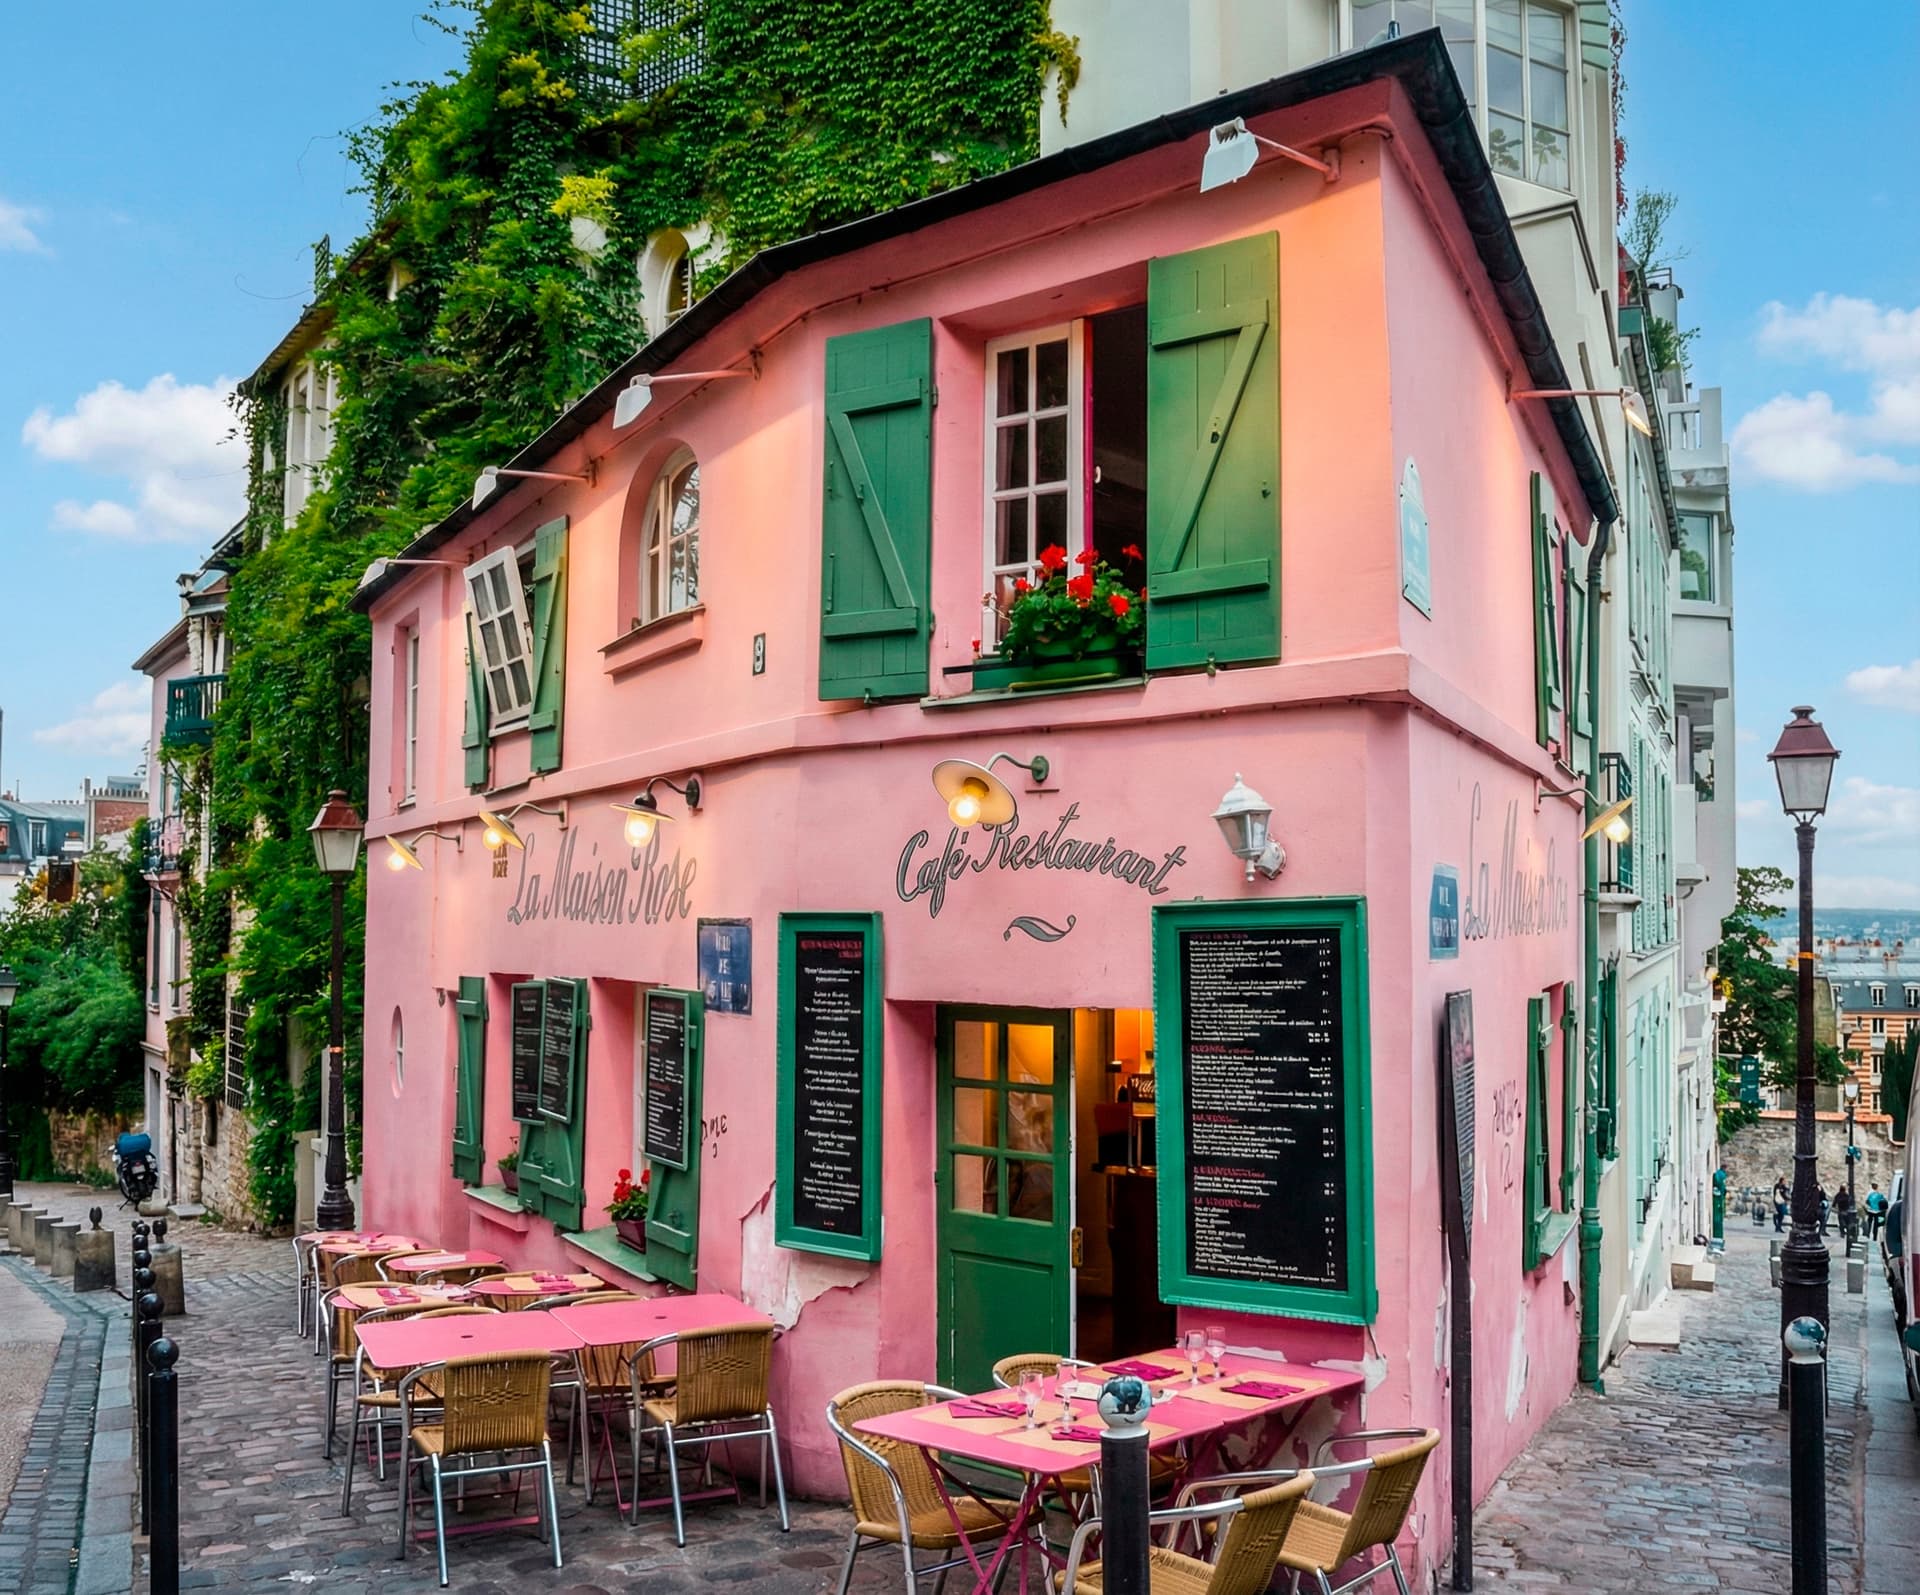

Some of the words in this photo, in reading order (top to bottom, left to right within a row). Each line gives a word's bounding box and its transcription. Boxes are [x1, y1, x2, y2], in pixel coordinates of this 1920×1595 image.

[507, 832, 541, 925] La
[543, 825, 628, 924] Maison
[628, 818, 697, 924] Rose
[896, 826, 972, 919] Café
[971, 801, 1186, 895] Restaurant
